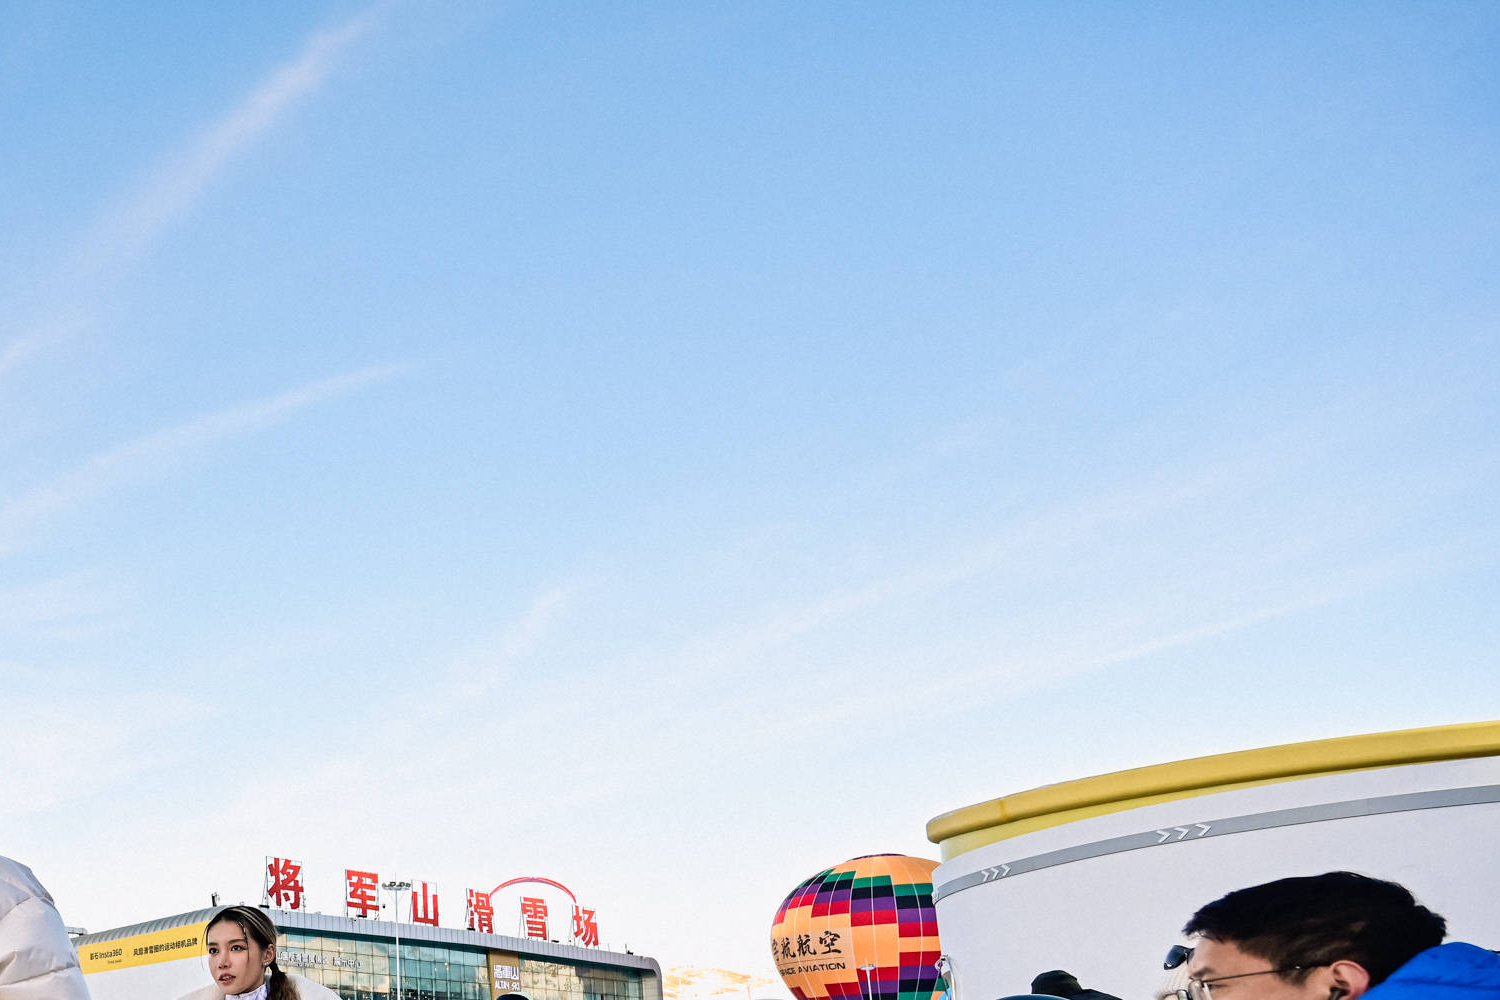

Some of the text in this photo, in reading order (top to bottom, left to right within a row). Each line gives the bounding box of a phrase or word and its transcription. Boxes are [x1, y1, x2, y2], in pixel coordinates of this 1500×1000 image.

[268, 856, 600, 948] 将军山滑雪场
[798, 962, 846, 973] AVIATION
